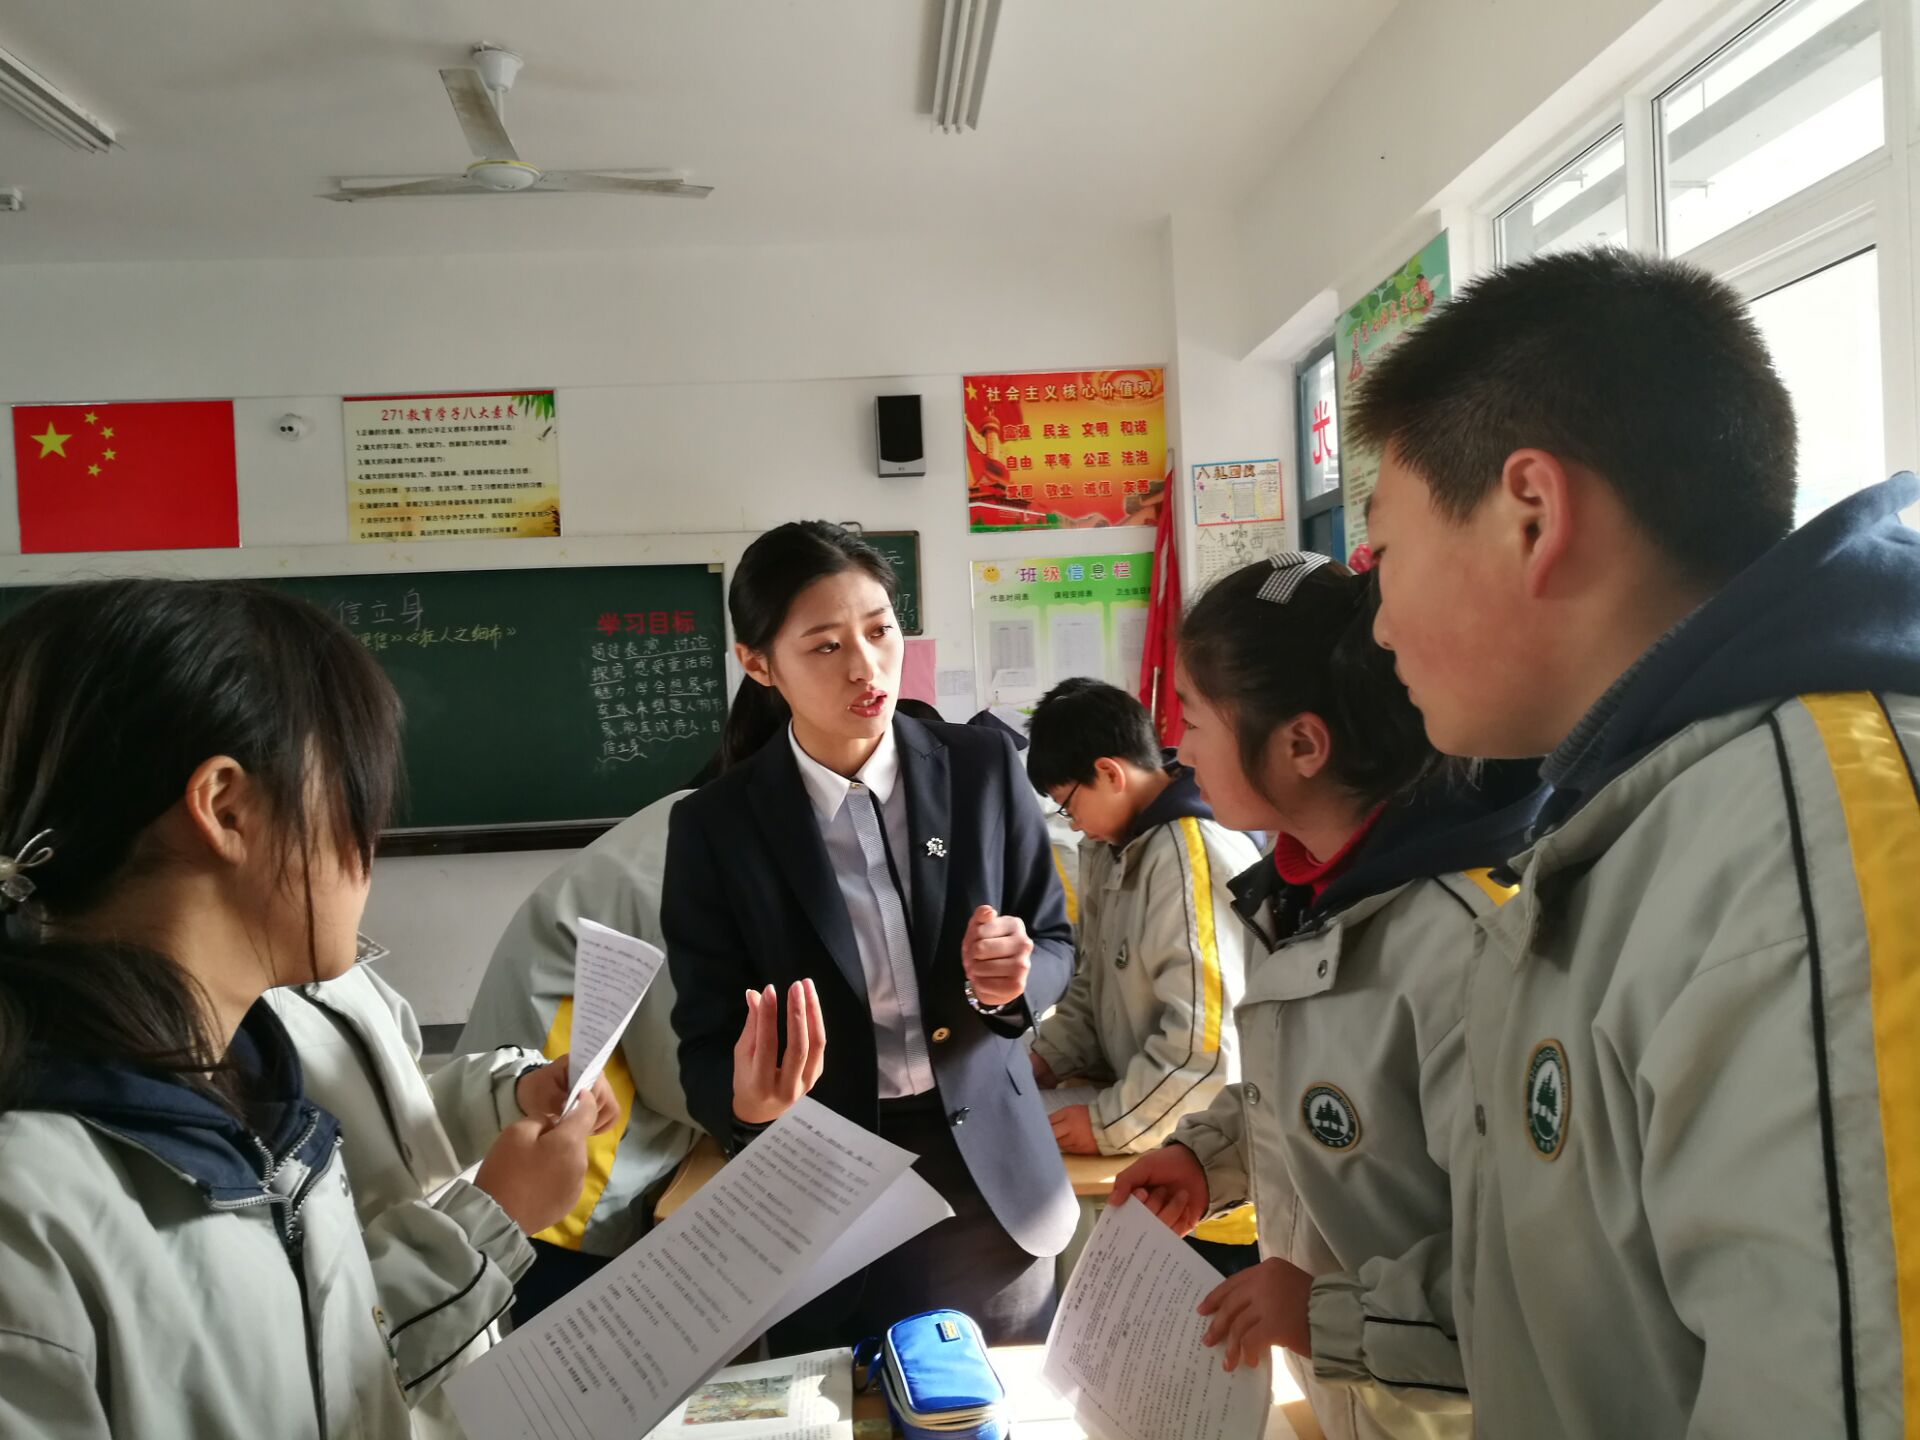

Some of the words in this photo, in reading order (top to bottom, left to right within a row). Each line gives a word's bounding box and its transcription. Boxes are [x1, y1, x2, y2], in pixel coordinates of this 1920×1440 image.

[986, 380, 1154, 403] 社会主义核心价值观
[381, 404, 518, 421] 271教育学子八大素养
[1003, 424, 1032, 441] 富强
[1043, 424, 1070, 439] 民主
[1082, 422, 1109, 437] 文明
[1120, 420, 1148, 436] 和谐
[1006, 455, 1032, 470] 自由
[1044, 453, 1071, 468] 平等
[1083, 452, 1111, 467] 公正
[1121, 450, 1149, 465] 法治
[1006, 484, 1034, 499] 爱国
[1045, 483, 1073, 498] 敬业
[1084, 482, 1112, 496] 诚信
[1123, 479, 1150, 494] 友善
[1019, 562, 1132, 583] 班级信息栏
[1115, 587, 1151, 597] 卫生值日
[595, 610, 697, 636] 学习目标
